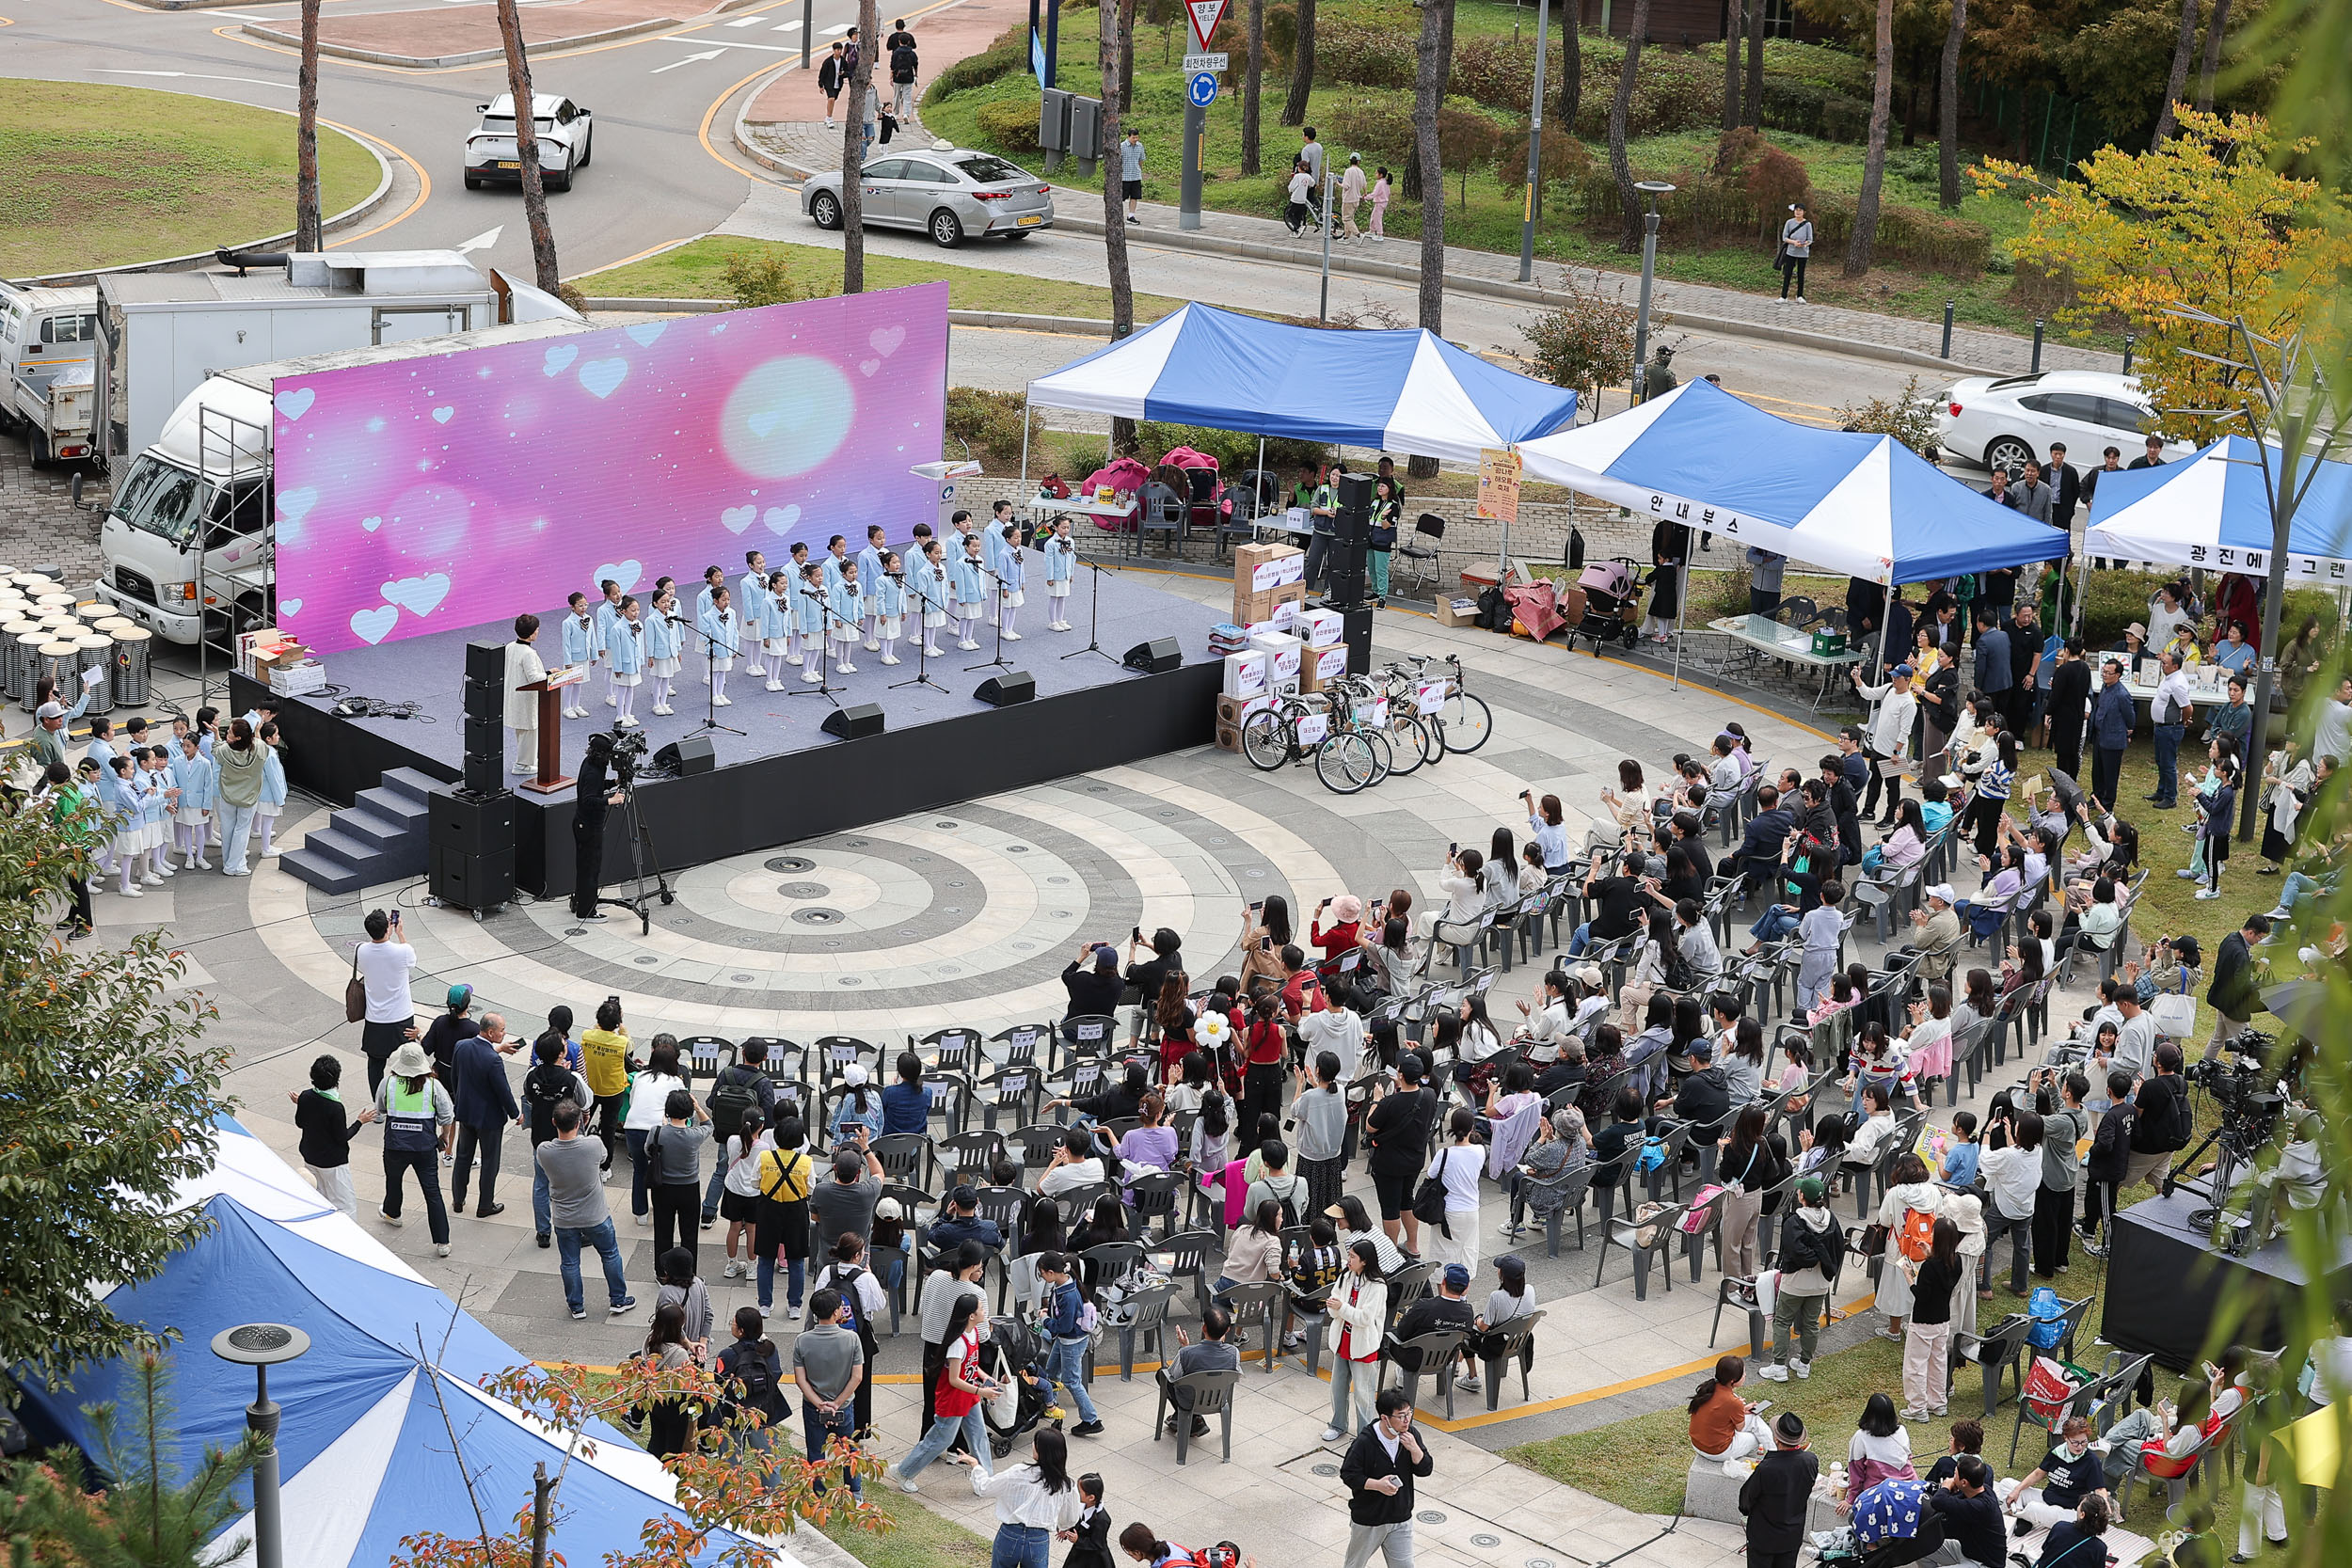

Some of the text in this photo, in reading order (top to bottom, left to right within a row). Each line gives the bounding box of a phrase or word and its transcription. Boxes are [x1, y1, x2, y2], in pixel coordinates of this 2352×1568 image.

[1198, 4, 1216, 14] 양보
[1198, 13, 1216, 22] YIELD
[1185, 56, 1226, 69] 회전차량우선
[1495, 467, 1513, 476] 광나루
[1494, 476, 1513, 484] 해오름
[1651, 495, 1739, 533] 안내부스
[1314, 1267, 1337, 1288] 35
[2054, 1469, 2069, 1479] SENIOR
[2058, 1465, 2071, 1475] WORLD
